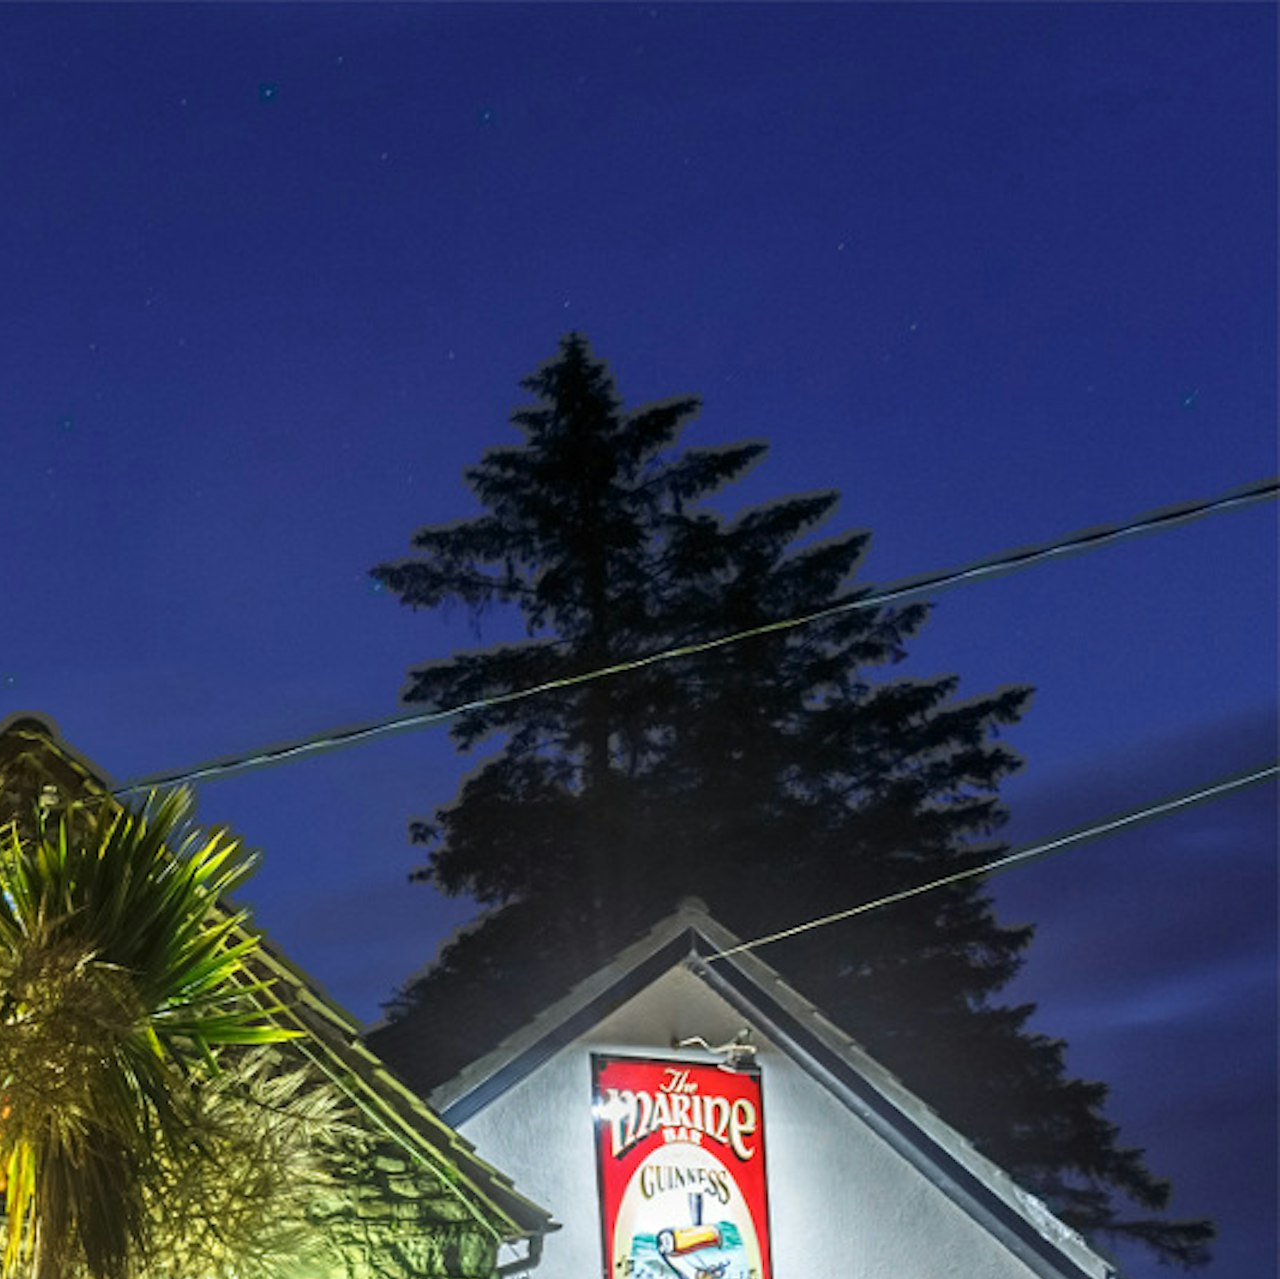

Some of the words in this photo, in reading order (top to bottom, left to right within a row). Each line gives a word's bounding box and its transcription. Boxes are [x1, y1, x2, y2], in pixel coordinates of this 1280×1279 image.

[659, 1068, 698, 1093] The
[662, 1127, 703, 1145] BAR
[640, 1165, 731, 1205] GUINNESS
